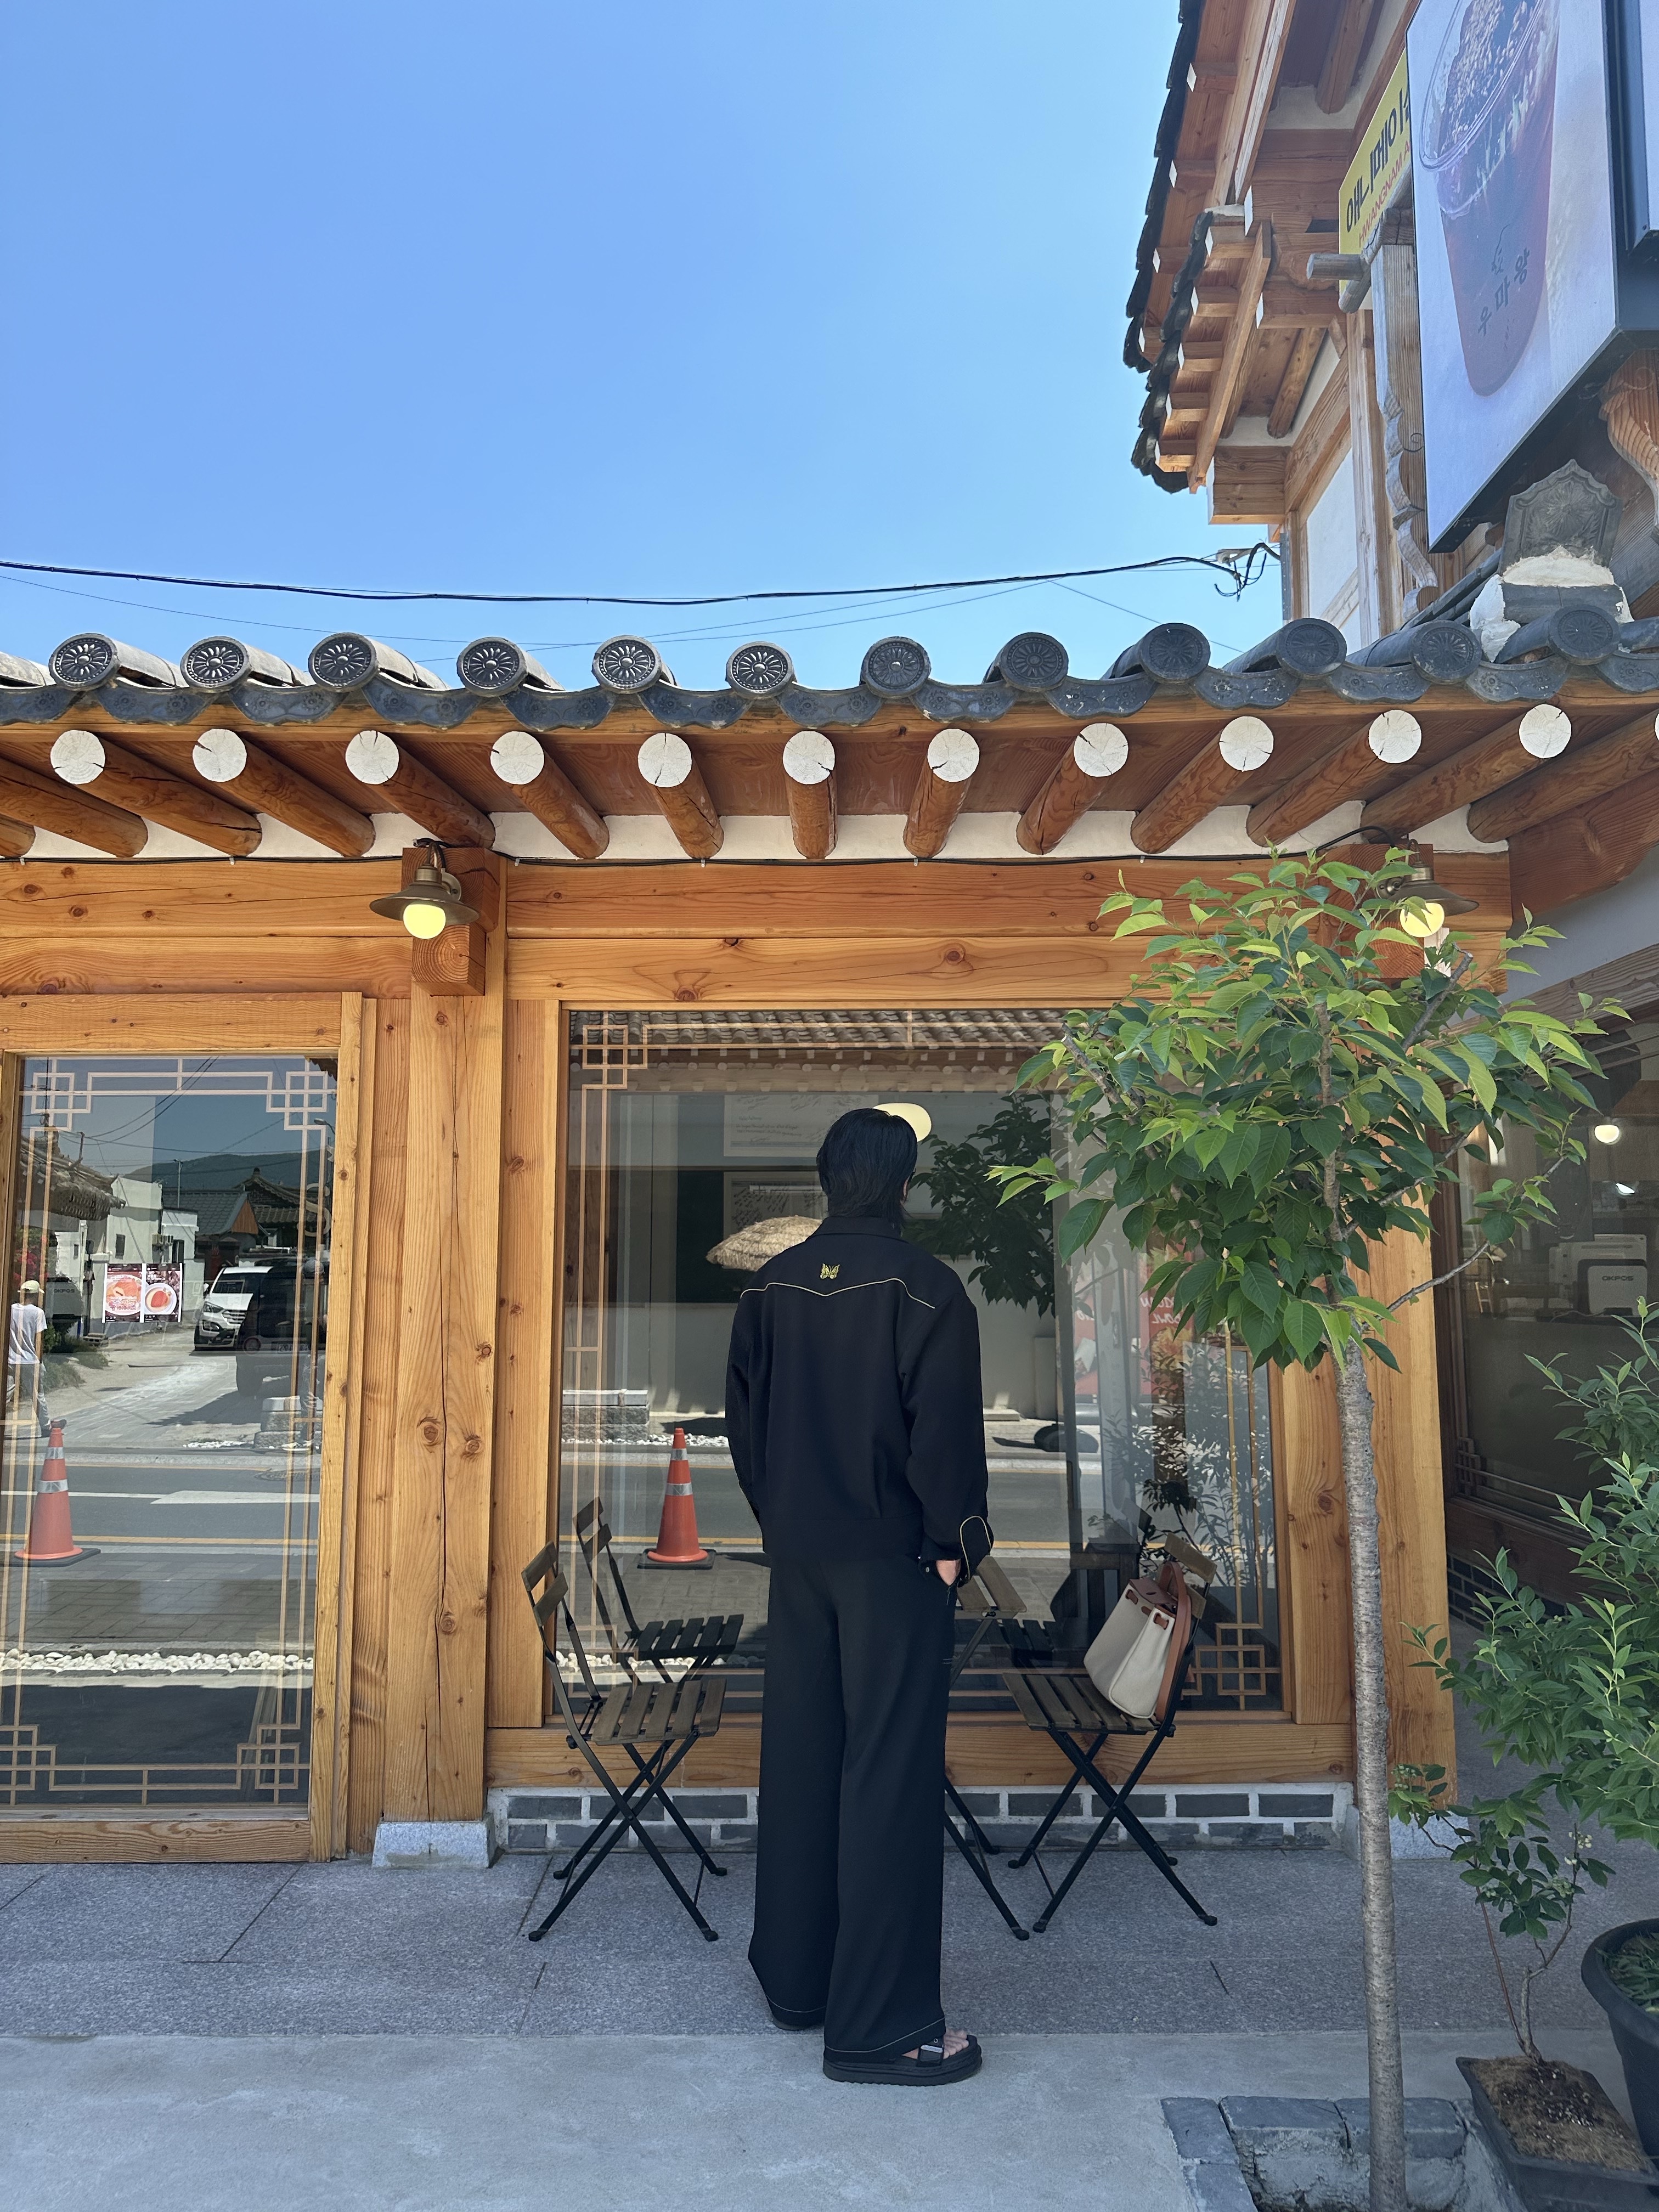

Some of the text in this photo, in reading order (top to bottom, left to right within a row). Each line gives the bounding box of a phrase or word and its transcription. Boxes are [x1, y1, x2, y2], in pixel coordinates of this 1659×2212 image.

[1346, 82, 1410, 233] 애니메이
[1359, 151, 1402, 247] HWANGNAM
[1478, 247, 1530, 336] 우마왕
